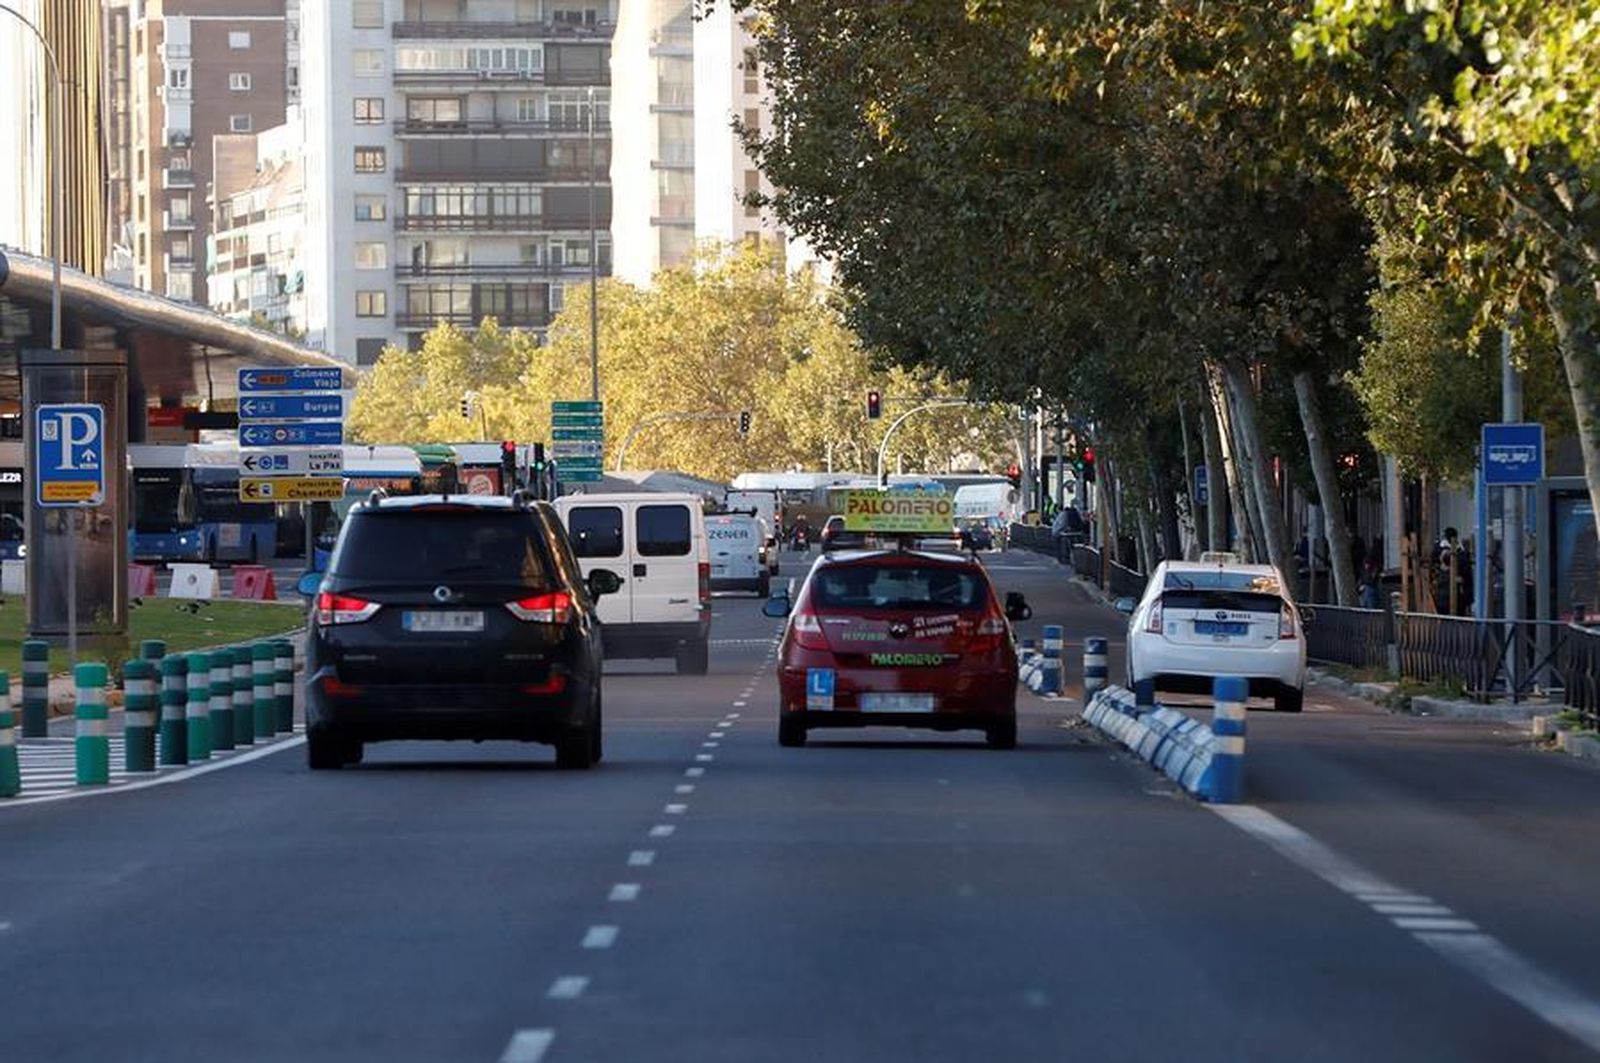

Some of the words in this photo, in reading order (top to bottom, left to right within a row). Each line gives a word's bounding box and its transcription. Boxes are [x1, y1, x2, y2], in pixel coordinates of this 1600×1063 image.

[293, 369, 340, 378] Colmenar
[314, 378, 340, 388] Viejo
[303, 401, 340, 413] Burgos
[54, 412, 98, 470] P
[847, 498, 951, 515] PALOMERO
[708, 529, 749, 540] ZENER
[869, 652, 943, 666] PALOMERO
[813, 672, 827, 693] L
